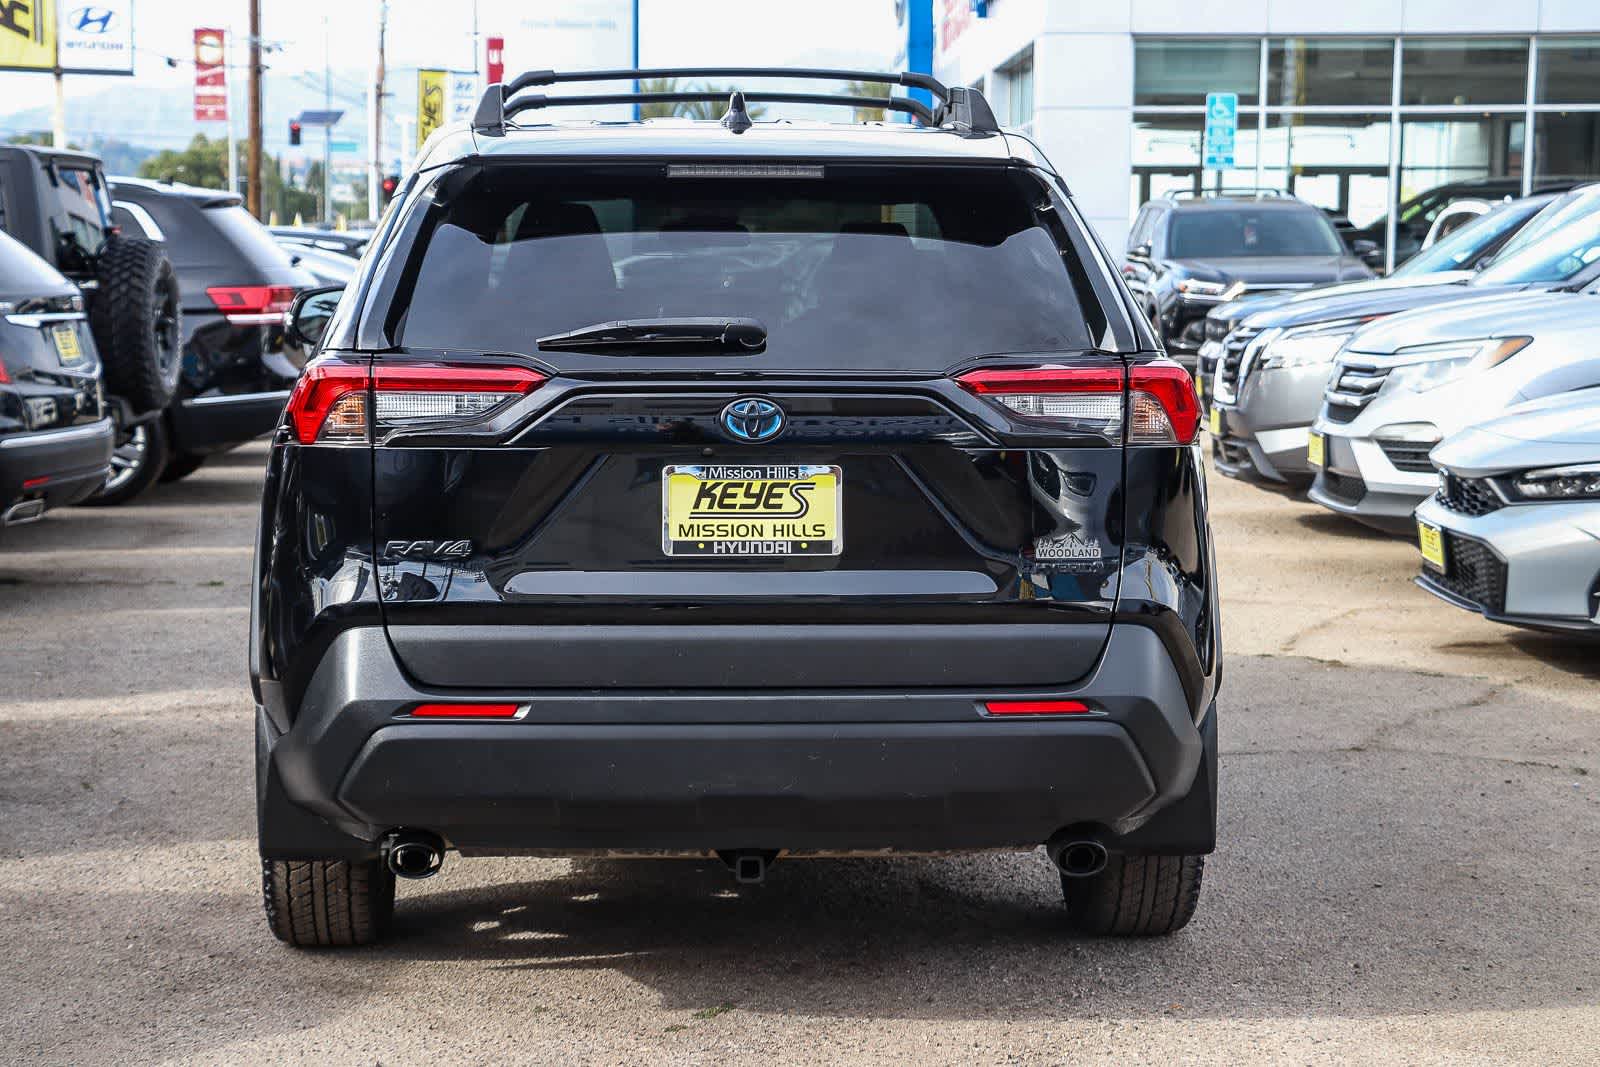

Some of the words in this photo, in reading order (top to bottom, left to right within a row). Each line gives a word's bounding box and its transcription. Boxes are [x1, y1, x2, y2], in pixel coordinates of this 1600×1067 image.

[708, 467, 762, 479] Mission
[766, 466, 797, 479] Hills
[688, 481, 816, 519] KEYES
[678, 523, 764, 538] MISSION
[773, 523, 826, 538] HILLS
[713, 541, 792, 554] HYUNDAI
[1037, 548, 1099, 557] WOODLAND
